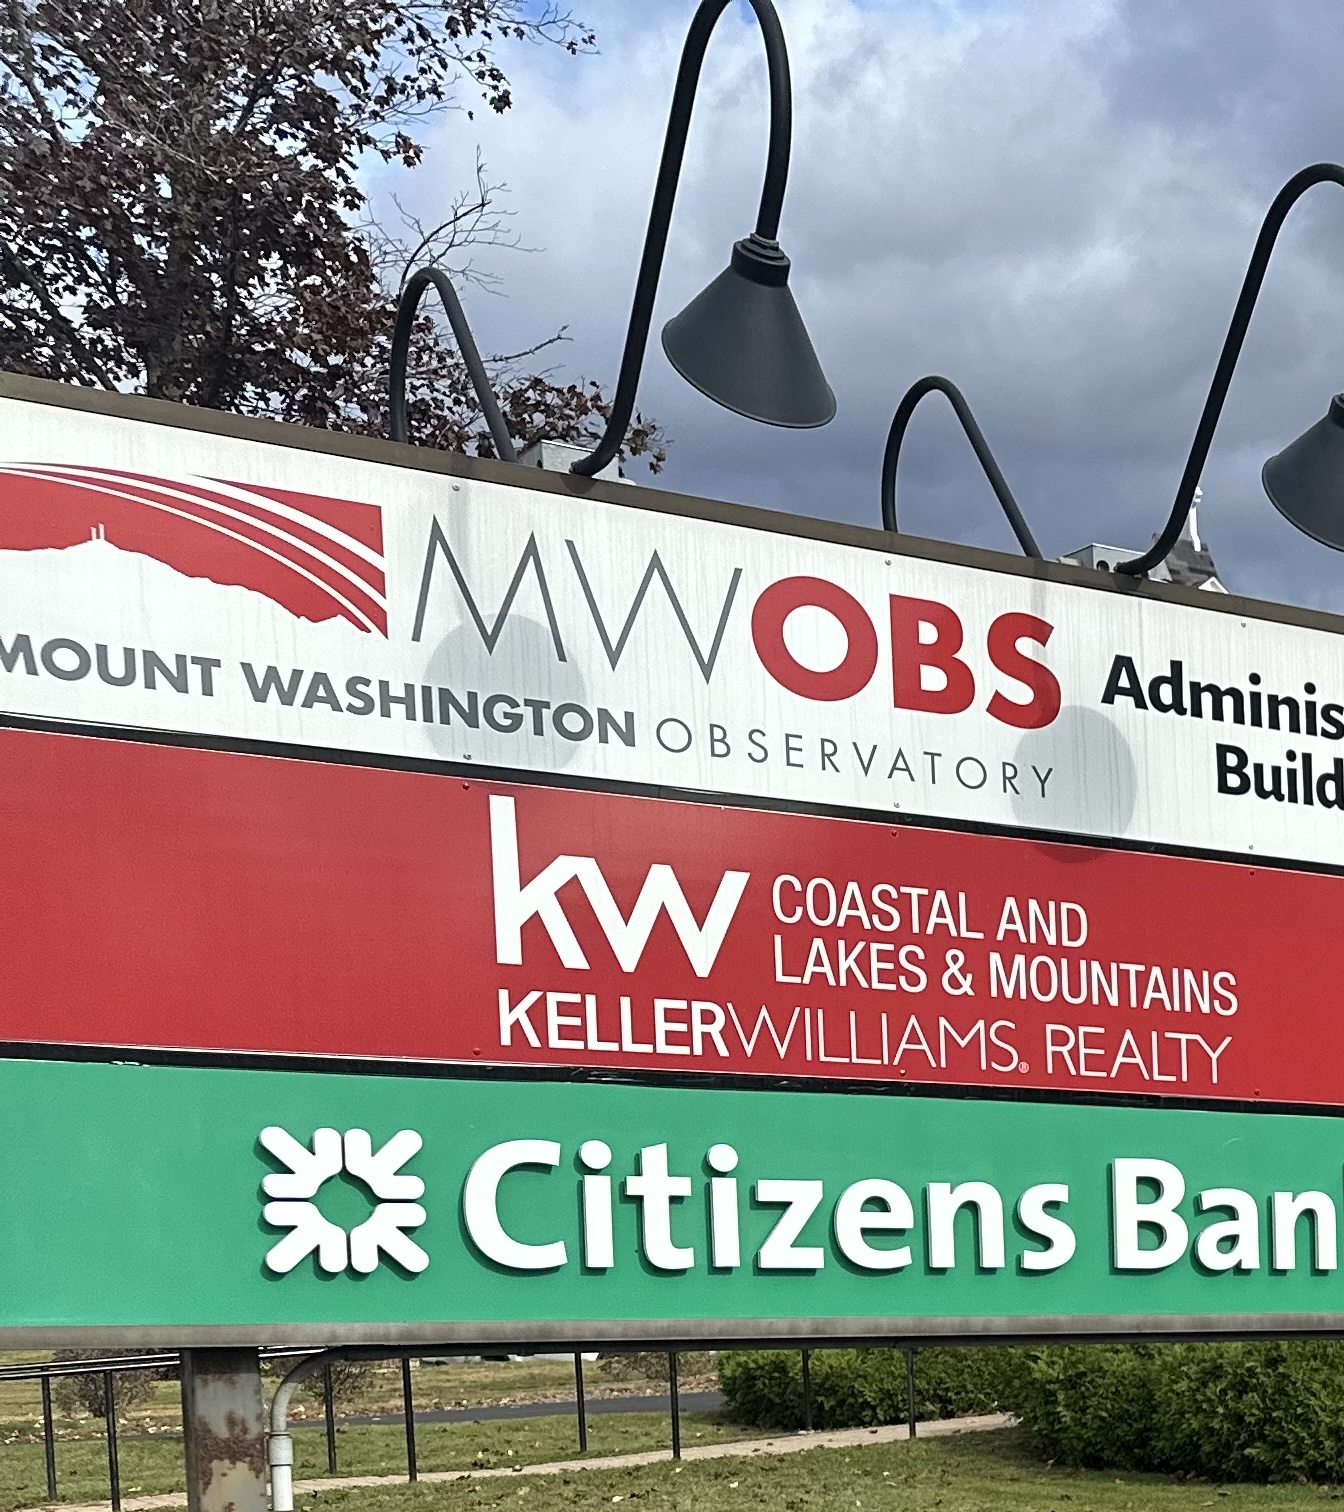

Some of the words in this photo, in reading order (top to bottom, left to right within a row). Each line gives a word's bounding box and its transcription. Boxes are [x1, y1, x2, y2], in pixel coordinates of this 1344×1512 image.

[411, 514, 1062, 730] MWOBS
[0, 633, 222, 697] MOUNT
[239, 661, 636, 748] WASHINGTON
[656, 717, 1054, 799] OBSERVATORY
[488, 794, 751, 978] kw
[772, 874, 985, 940] COASTAL
[996, 896, 1088, 948] AND
[773, 934, 928, 993] LAKES
[941, 948, 975, 996] &
[989, 951, 1239, 1016] MOUNTAINS
[1045, 1023, 1233, 1084] REALTY
[462, 1138, 1078, 1271] Citizens
